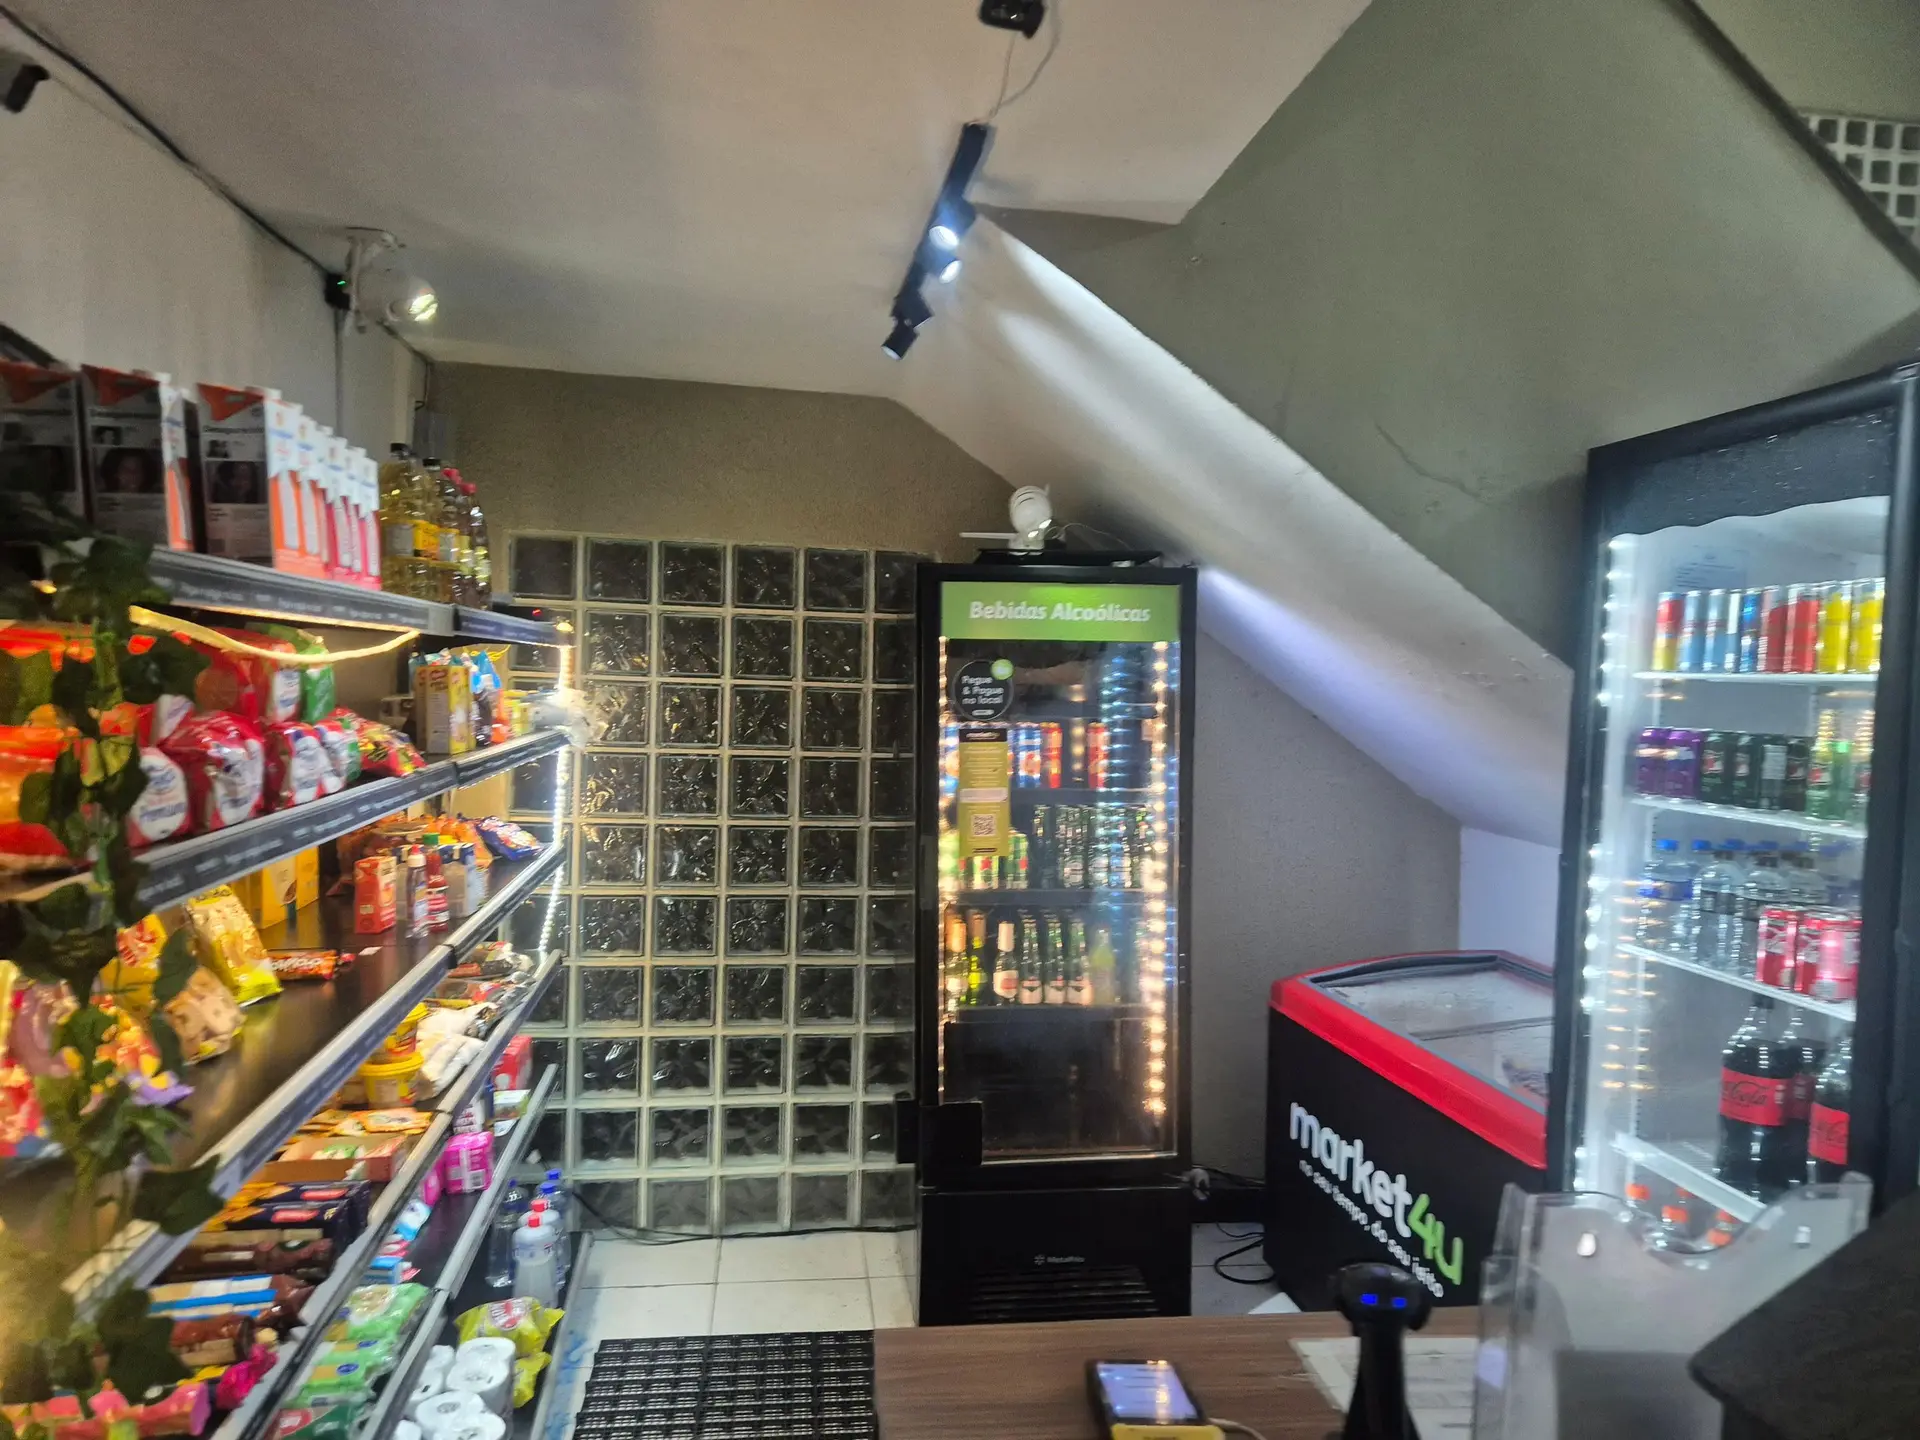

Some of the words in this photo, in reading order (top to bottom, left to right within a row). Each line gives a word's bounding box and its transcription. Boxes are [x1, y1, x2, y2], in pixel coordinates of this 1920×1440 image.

[970, 601, 1047, 620] Bebidas
[1050, 602, 1151, 622] Alcoólicas
[977, 695, 1004, 705] local
[1289, 1101, 1464, 1286] market4u
[1313, 1171, 1333, 1194] seu
[1370, 1220, 1388, 1243] do
[1387, 1239, 1411, 1266] seu
